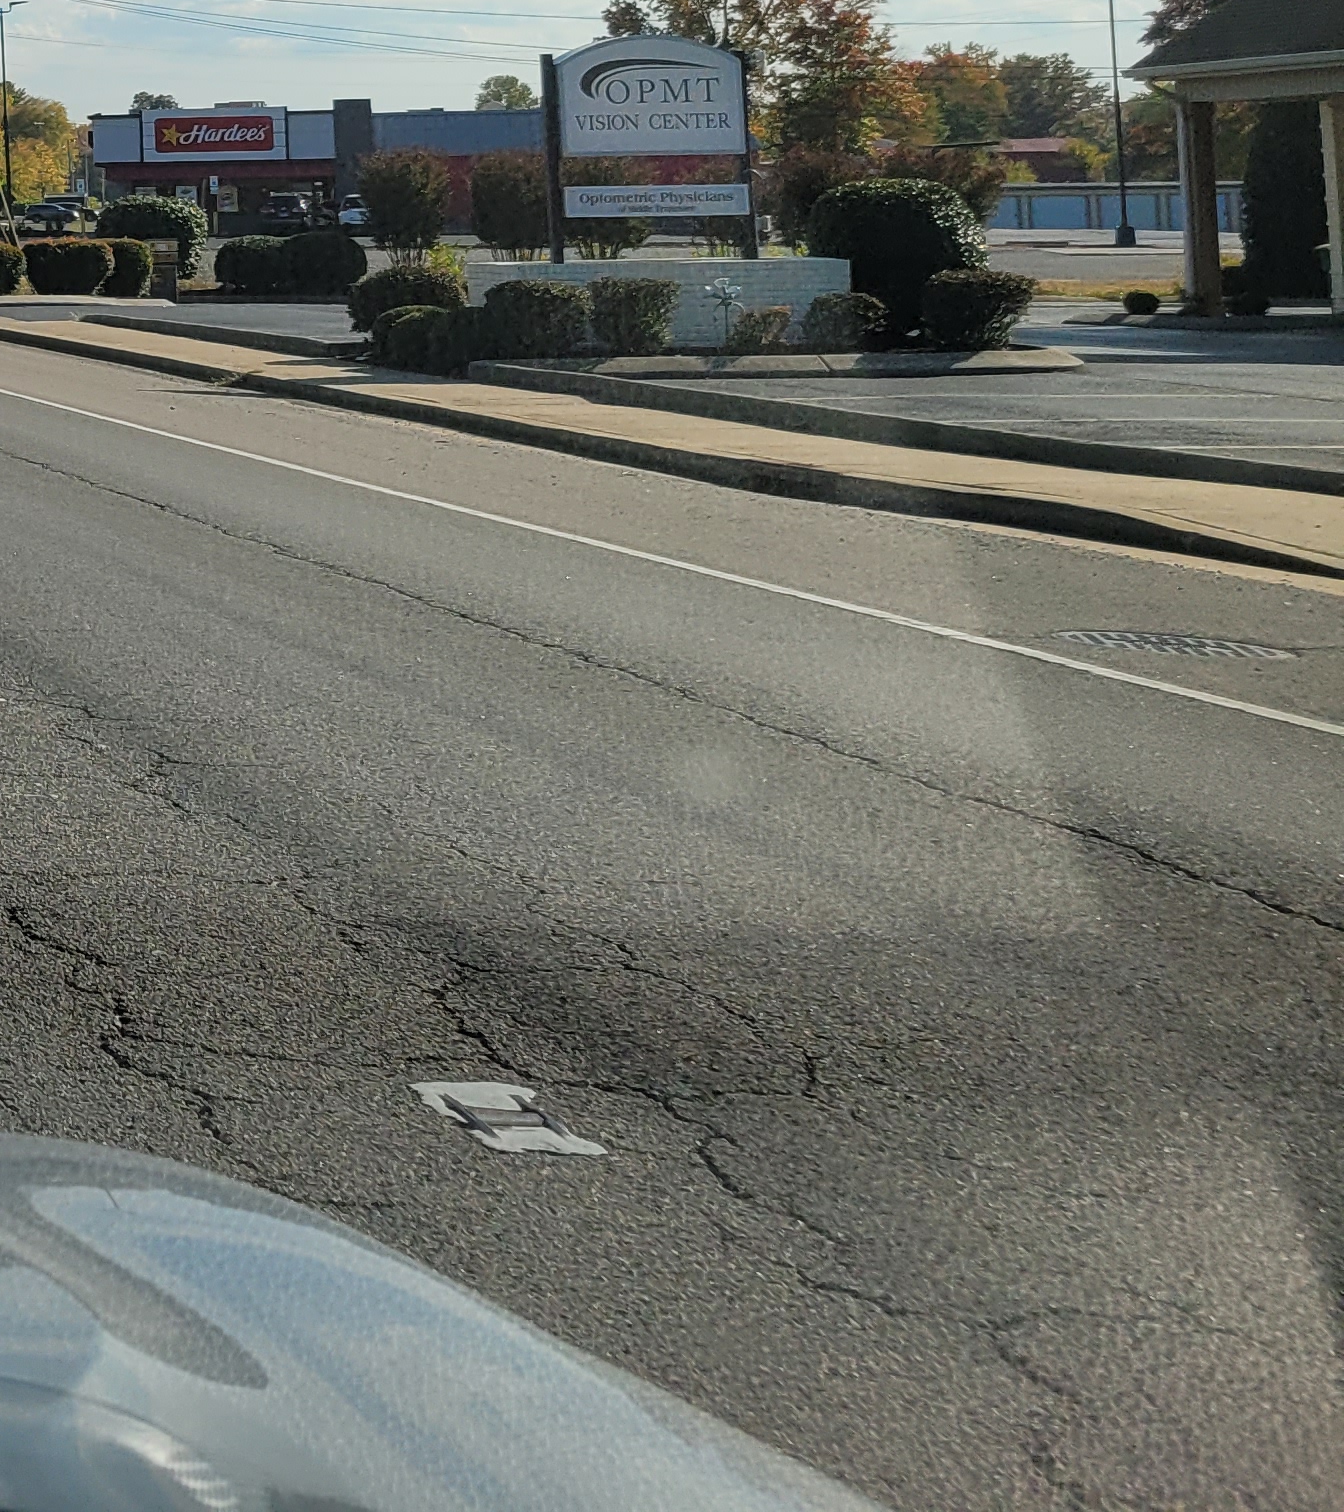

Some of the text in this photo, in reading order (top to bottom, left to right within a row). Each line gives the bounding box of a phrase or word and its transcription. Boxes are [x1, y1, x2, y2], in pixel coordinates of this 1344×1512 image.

[606, 77, 720, 104] OPMT
[574, 111, 732, 131] VISION CENTER
[179, 124, 270, 145] Hardee's
[578, 190, 735, 206] Optometric Physicians
